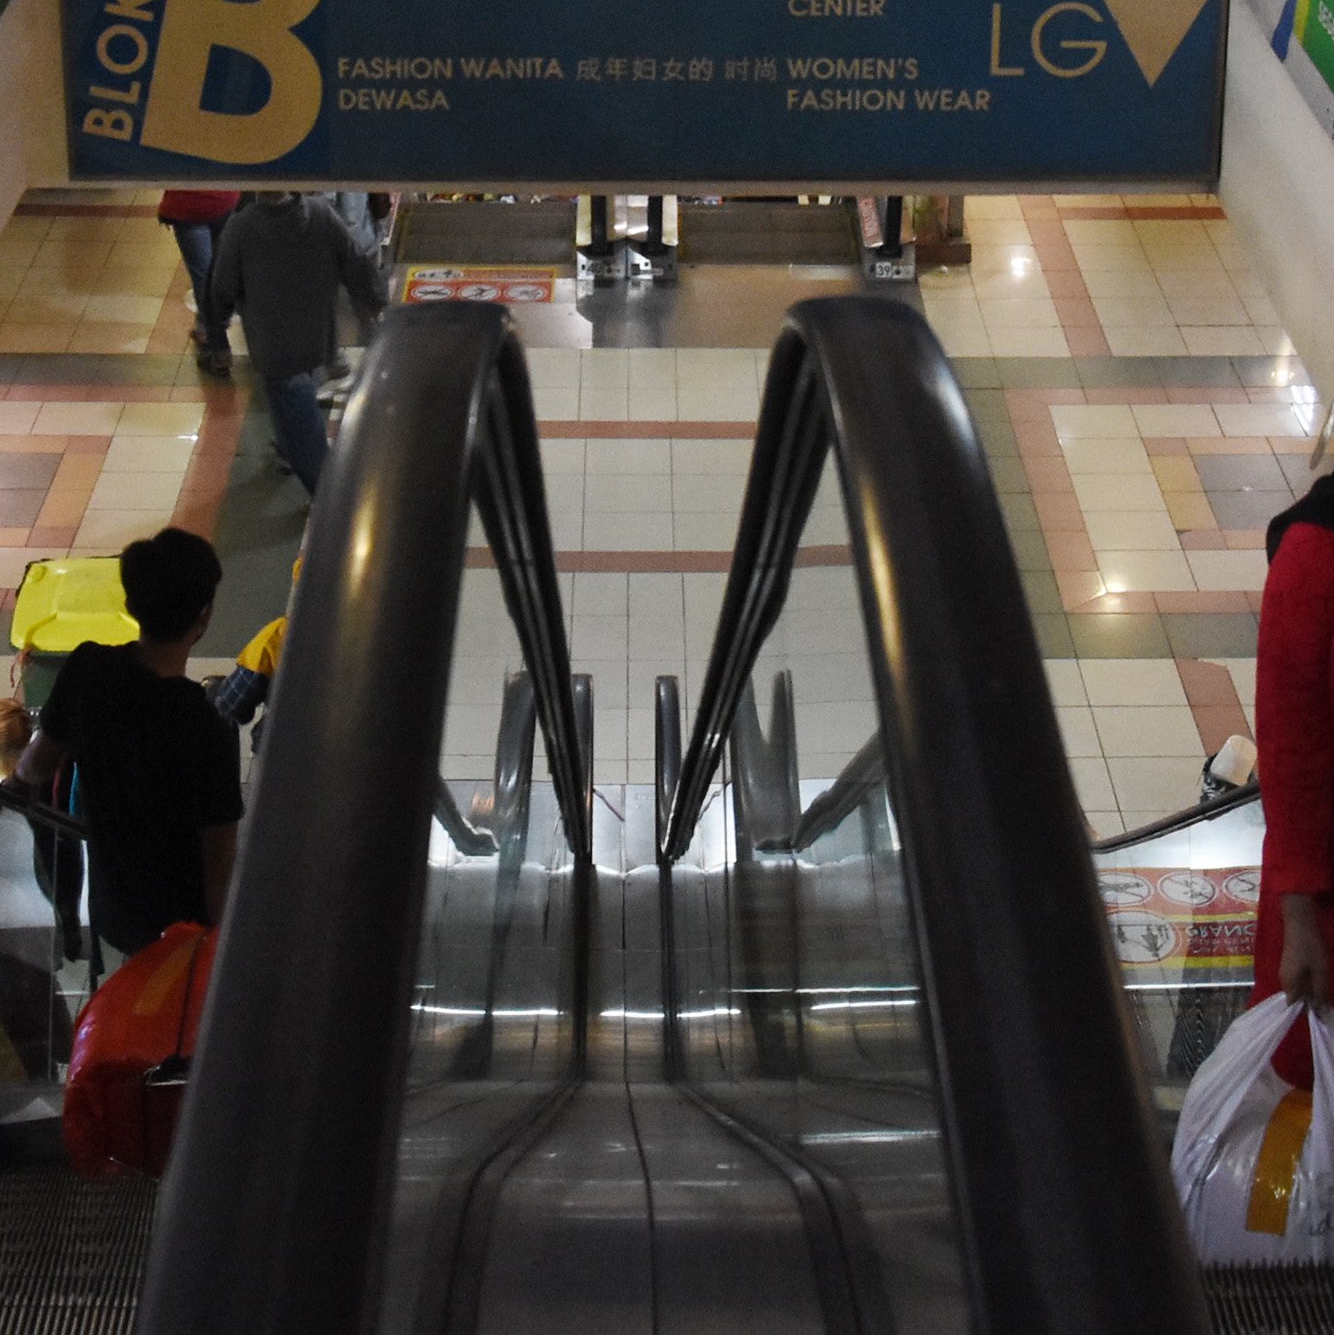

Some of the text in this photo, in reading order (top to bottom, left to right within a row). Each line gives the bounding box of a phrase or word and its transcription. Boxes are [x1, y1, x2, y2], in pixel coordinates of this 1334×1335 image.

[990, 1, 1109, 79] LG
[337, 57, 564, 81] FASHION WANITA
[575, 57, 778, 82] 成年妇女的 时尚
[787, 58, 919, 81] WOMEN'S
[337, 87, 450, 112] DEWASA
[786, 88, 992, 112] FASHION WEAR
